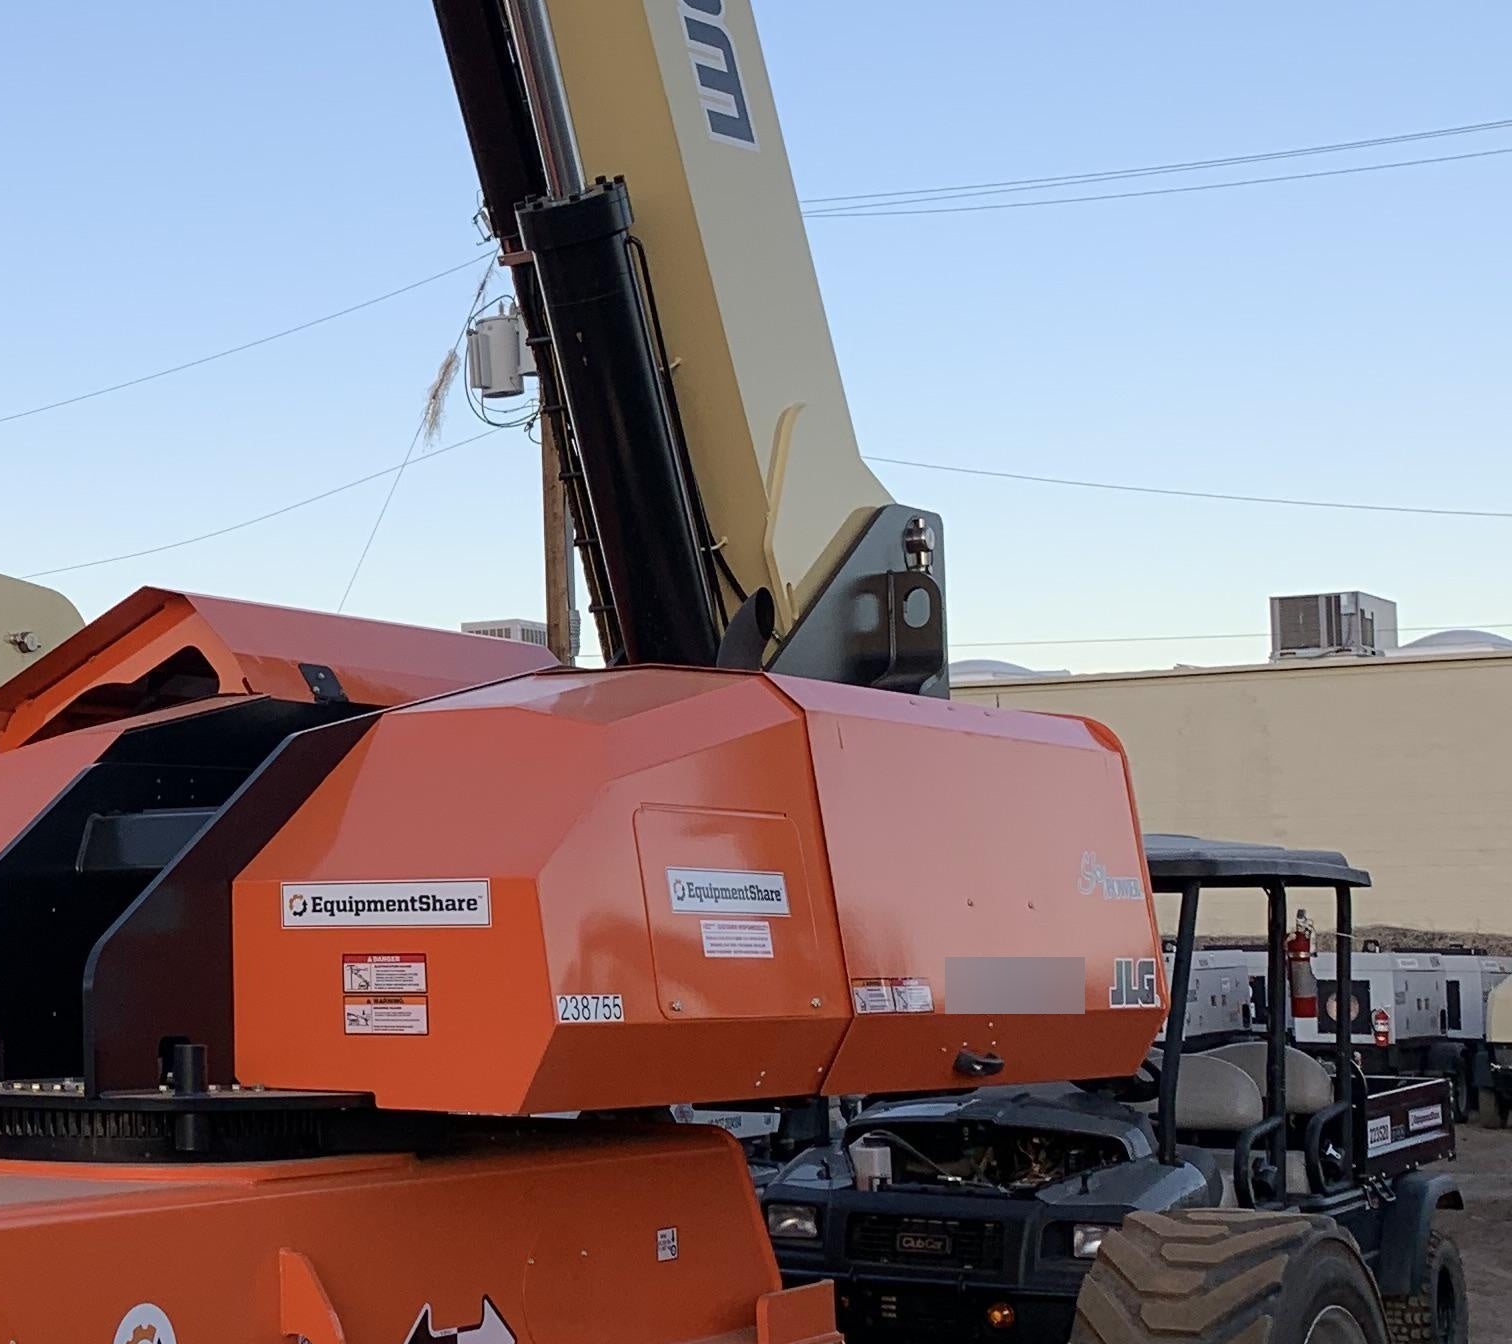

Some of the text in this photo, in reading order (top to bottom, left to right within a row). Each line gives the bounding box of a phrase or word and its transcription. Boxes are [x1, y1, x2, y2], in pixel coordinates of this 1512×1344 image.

[686, 882, 782, 904] EquipmentShare
[311, 894, 478, 917] EquipmentShare
[1109, 958, 1157, 1008] JLG
[559, 996, 622, 1021] 238755
